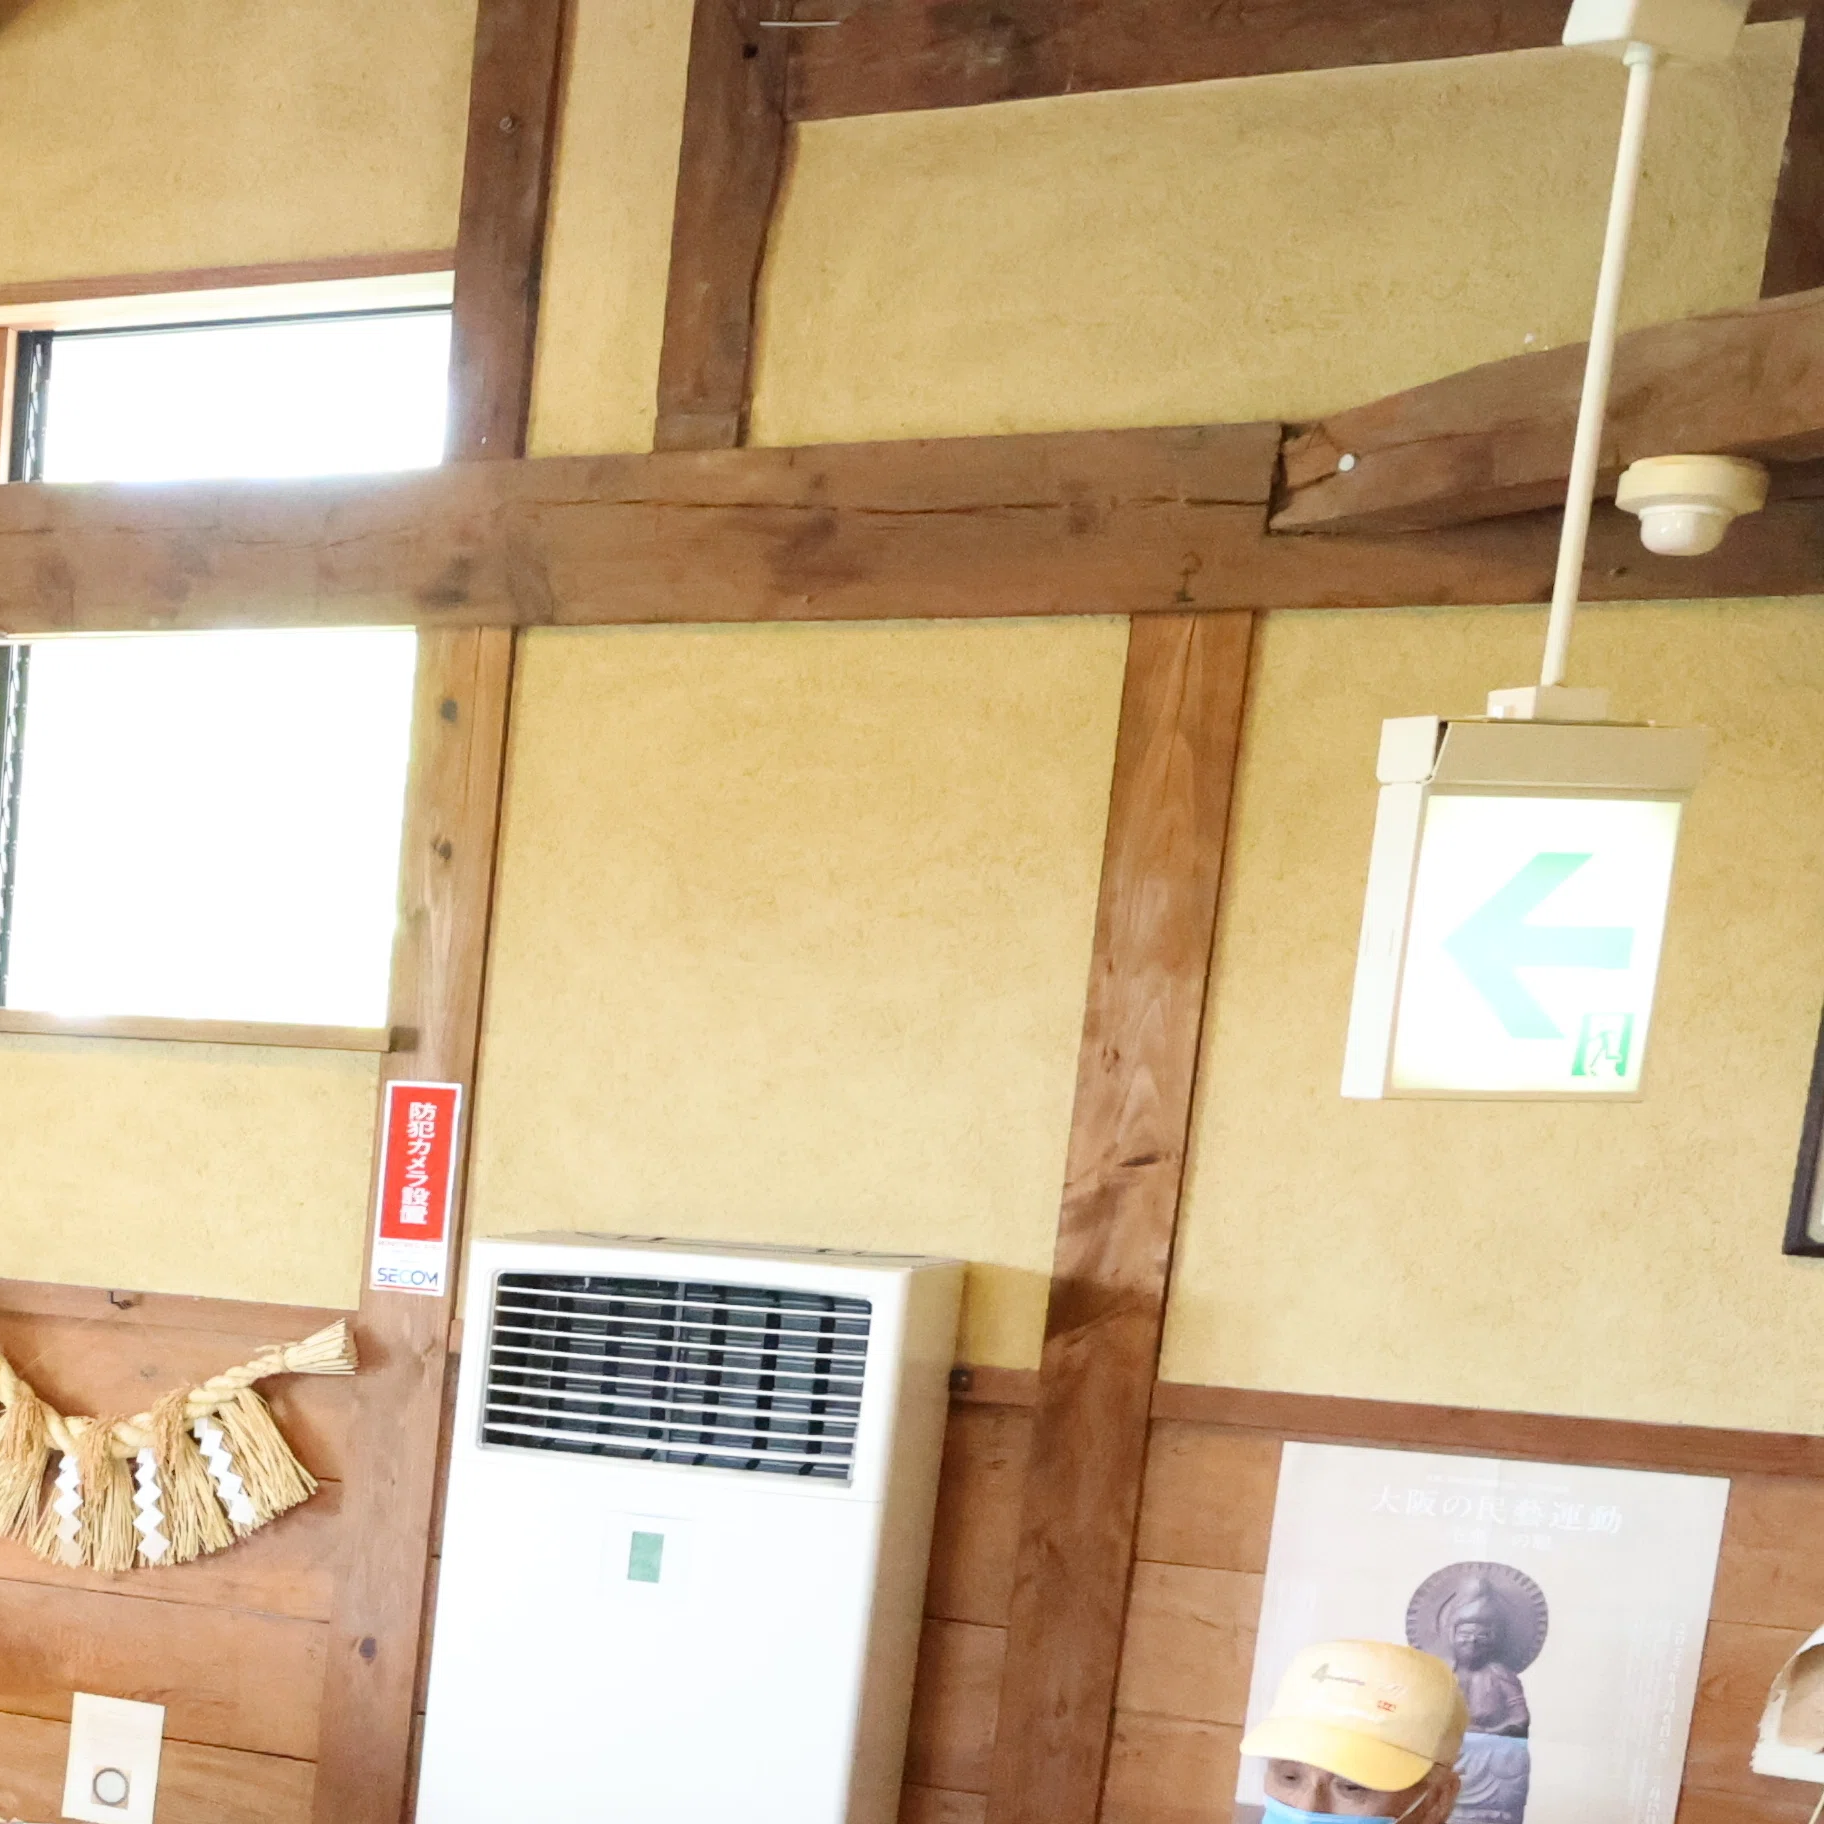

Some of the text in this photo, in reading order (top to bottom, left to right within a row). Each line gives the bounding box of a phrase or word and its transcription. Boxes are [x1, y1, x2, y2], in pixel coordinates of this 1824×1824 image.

[399, 1101, 438, 1225] 防犯カメラ設置
[377, 1267, 439, 1286] SECOM
